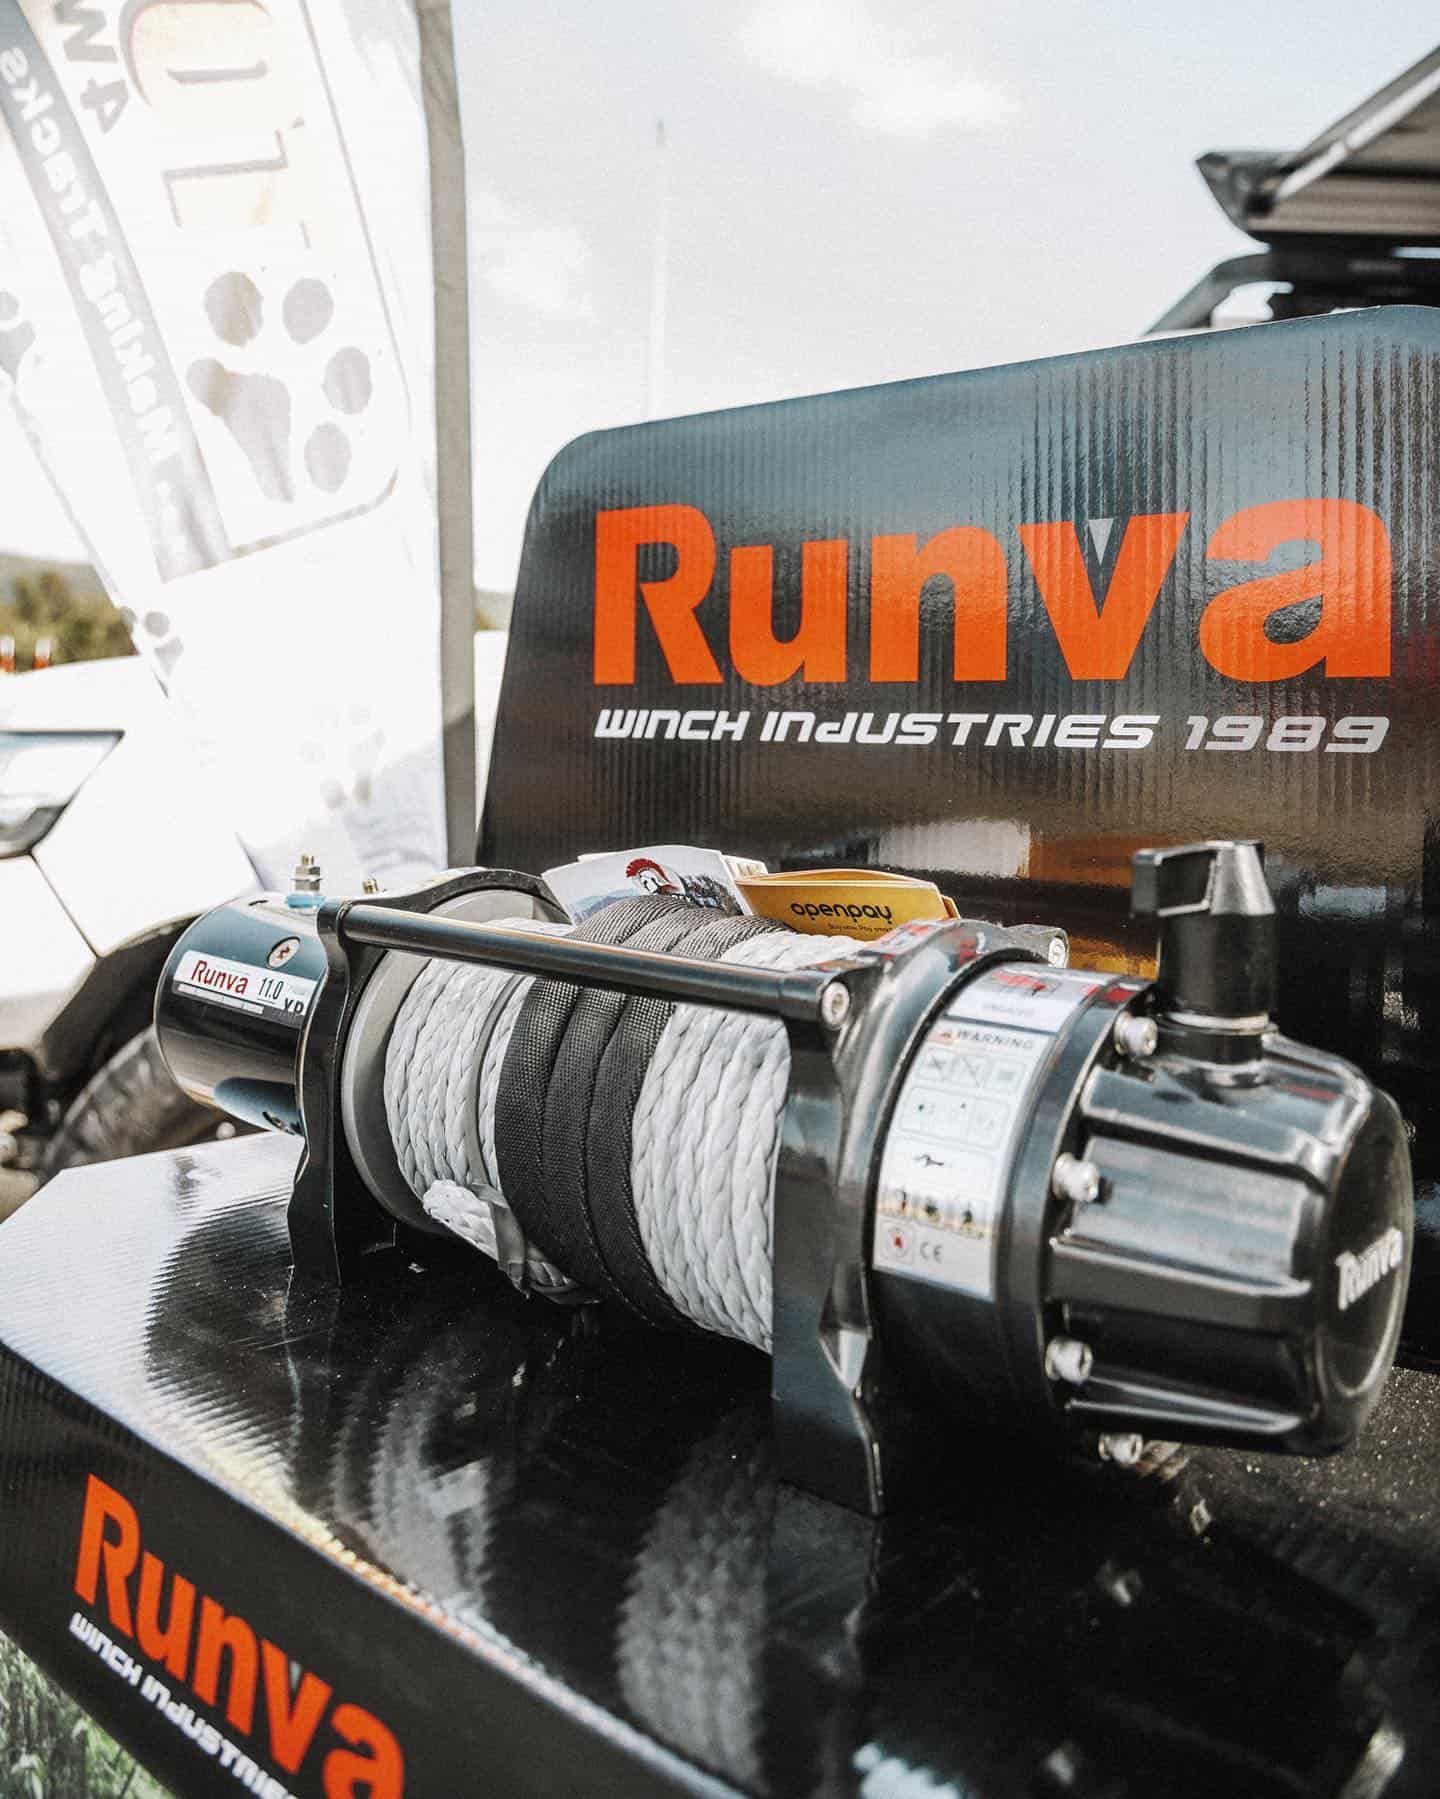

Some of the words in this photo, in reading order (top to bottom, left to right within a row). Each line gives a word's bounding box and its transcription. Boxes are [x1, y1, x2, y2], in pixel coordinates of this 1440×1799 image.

[594, 498, 1392, 687] Runva
[1184, 715, 1391, 754] 1989
[790, 902, 893, 924] openpay
[191, 960, 248, 996] Runva
[258, 976, 285, 1000] 11.0
[957, 1029, 1036, 1050] WARNING
[74, 1472, 405, 1799] Runva
